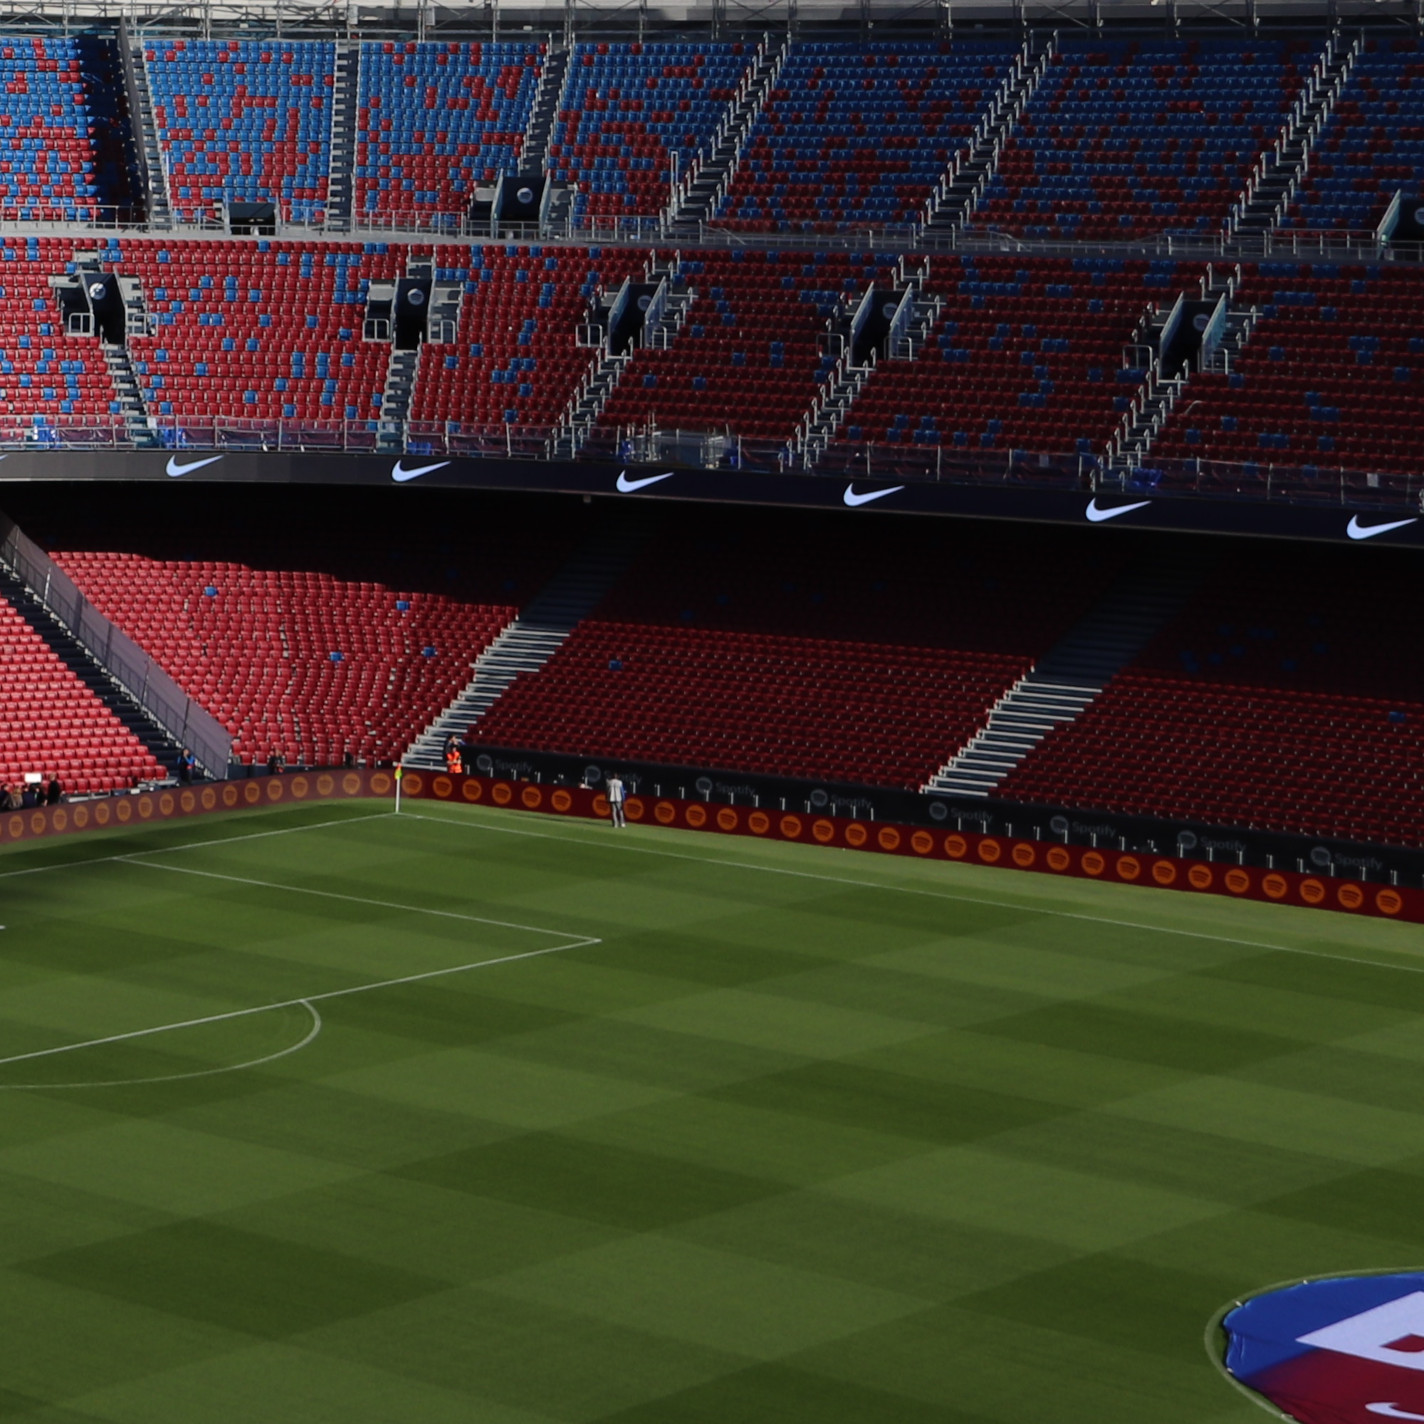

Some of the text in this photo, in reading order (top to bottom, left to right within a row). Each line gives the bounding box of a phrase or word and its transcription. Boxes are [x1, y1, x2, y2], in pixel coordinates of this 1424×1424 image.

[495, 758, 533, 773] Spotify
[716, 782, 756, 796] Spotify
[831, 795, 871, 809] Spotify
[951, 807, 992, 823] Spotify
[1072, 821, 1116, 837] Spotify
[1200, 836, 1246, 851] Spotify
[1334, 854, 1382, 870] Spotify
